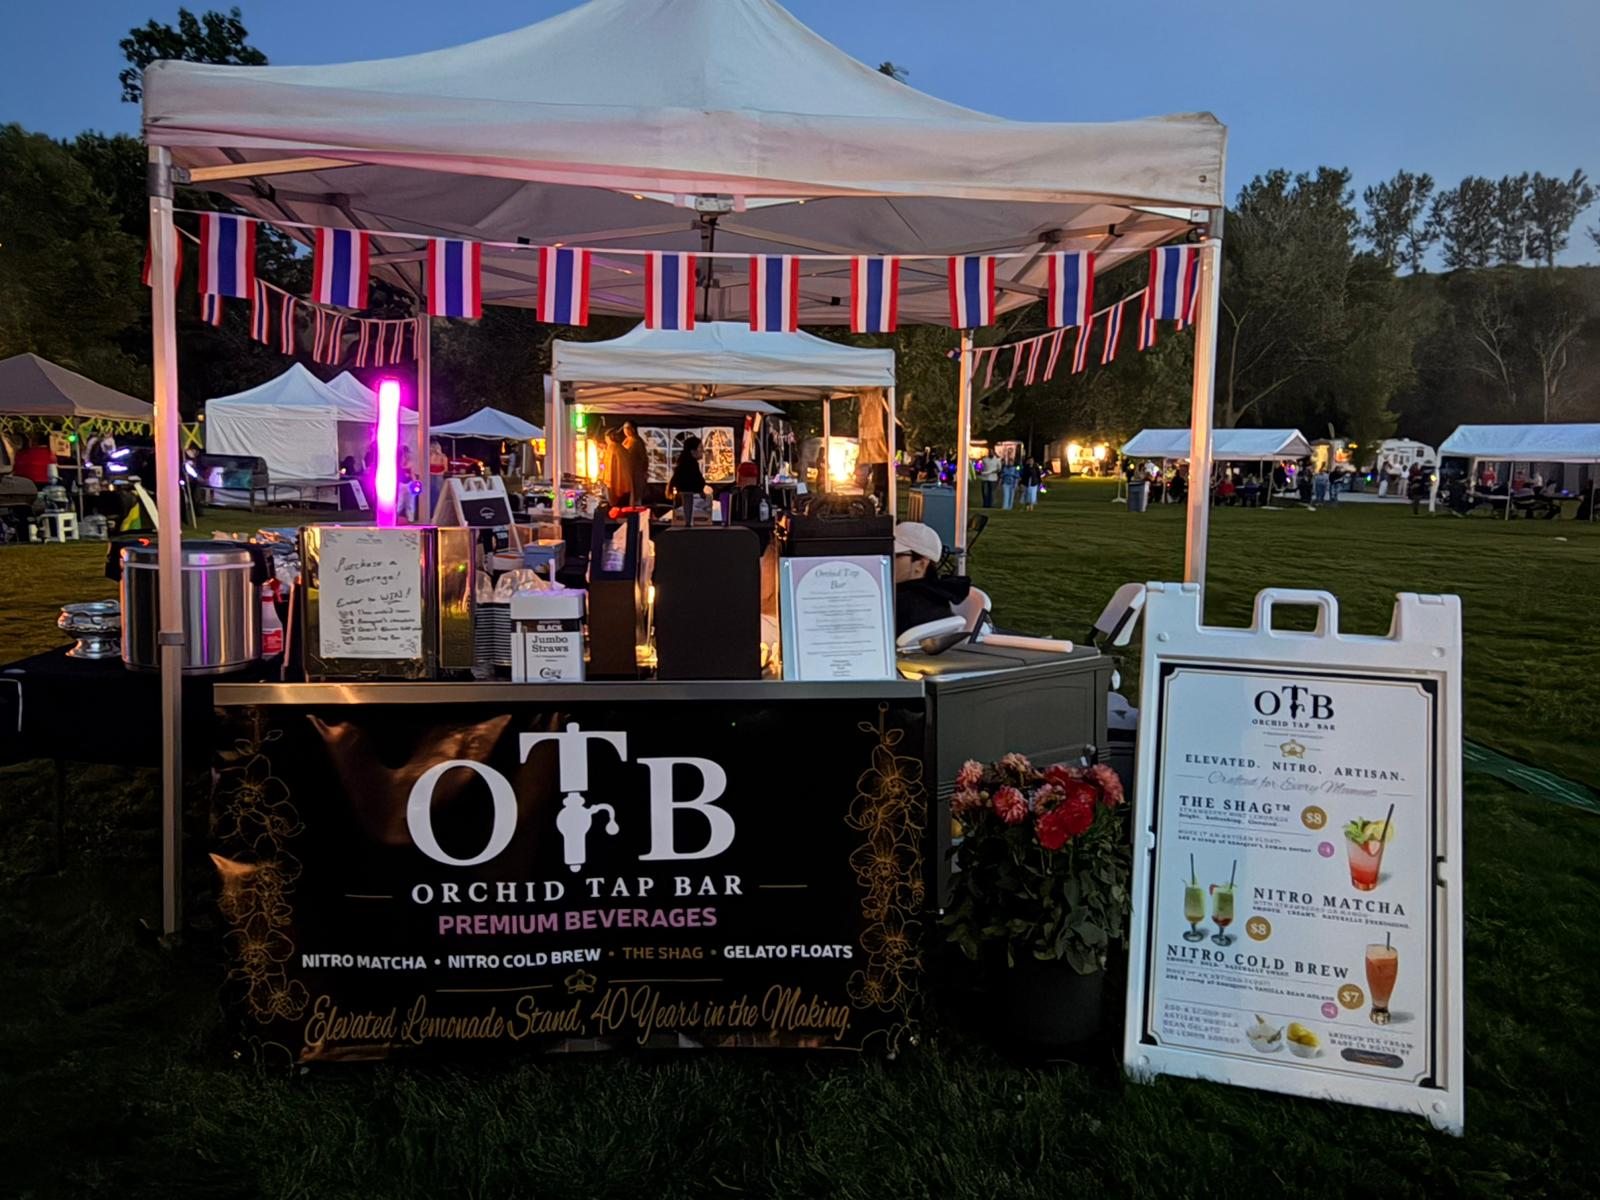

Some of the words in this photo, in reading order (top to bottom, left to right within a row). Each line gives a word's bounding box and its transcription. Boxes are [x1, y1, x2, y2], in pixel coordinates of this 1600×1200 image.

[532, 635, 568, 644] Jumbo
[536, 624, 563, 632] BLACK
[531, 644, 569, 653] Straws
[1254, 685, 1335, 720] OTB
[1251, 718, 1289, 728] ORCHID
[1292, 721, 1310, 729] TAP
[1317, 723, 1336, 731] BAR
[1185, 753, 1261, 769] ELEVATED.
[1272, 761, 1322, 774] NITRO.
[1334, 766, 1407, 782] ARTISAN.
[406, 722, 736, 872] OTB
[1179, 794, 1215, 809] THE
[1304, 811, 1323, 825] $8
[411, 881, 565, 905] ORCHID
[586, 877, 654, 898] TAP
[674, 875, 743, 897] BAR
[1254, 887, 1314, 905] NITRO
[1322, 895, 1406, 916] MATCHA
[439, 912, 558, 935] PREMIUM
[565, 907, 717, 931] BEVERAGES
[1250, 922, 1267, 936] $8
[302, 954, 354, 969] NITRO
[357, 955, 427, 970] MATCHA
[448, 954, 500, 969] NITRO
[503, 953, 548, 968] COLD
[551, 948, 601, 965] BREW
[622, 946, 655, 960] THE
[658, 946, 704, 960] SHAG
[723, 944, 788, 959] GELATO
[790, 944, 853, 959] FLOATS
[1167, 943, 1226, 962] NITRO
[1234, 953, 1285, 971] COLD
[1295, 960, 1350, 980] BREW
[1343, 991, 1360, 1003] $7
[304, 994, 398, 1047] Elevated
[401, 994, 505, 1045] Lemonade
[506, 995, 586, 1040] Stand,
[591, 986, 628, 1036] 40
[630, 984, 701, 1046] Years
[703, 998, 726, 1028] in
[727, 994, 759, 1028] the
[761, 984, 851, 1041] Making.
